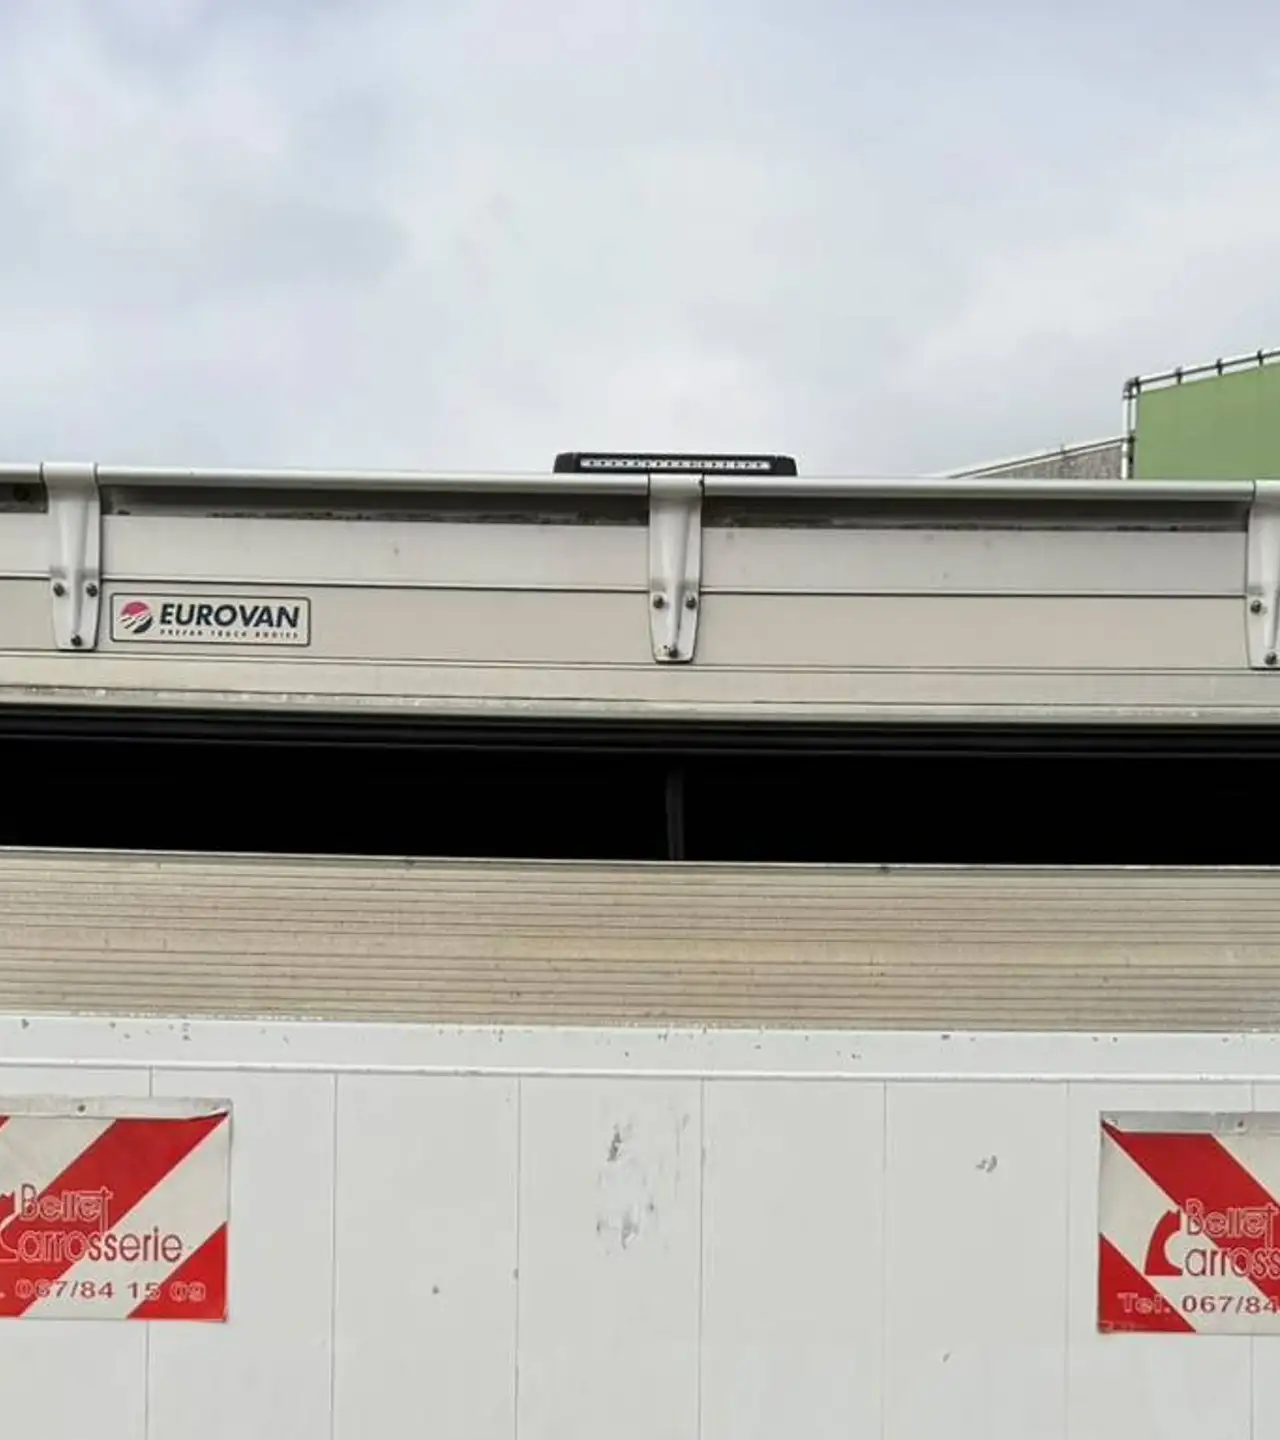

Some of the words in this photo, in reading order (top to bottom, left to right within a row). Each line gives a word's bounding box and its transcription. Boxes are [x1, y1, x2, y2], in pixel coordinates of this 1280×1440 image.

[159, 602, 300, 628] EUROVAN
[20, 1183, 113, 1231] Bellet
[1186, 1198, 1279, 1246] Bellet
[15, 1278, 115, 1299] 067/84
[1117, 1292, 1171, 1315] Tel.
[1181, 1294, 1280, 1315] 067/84
